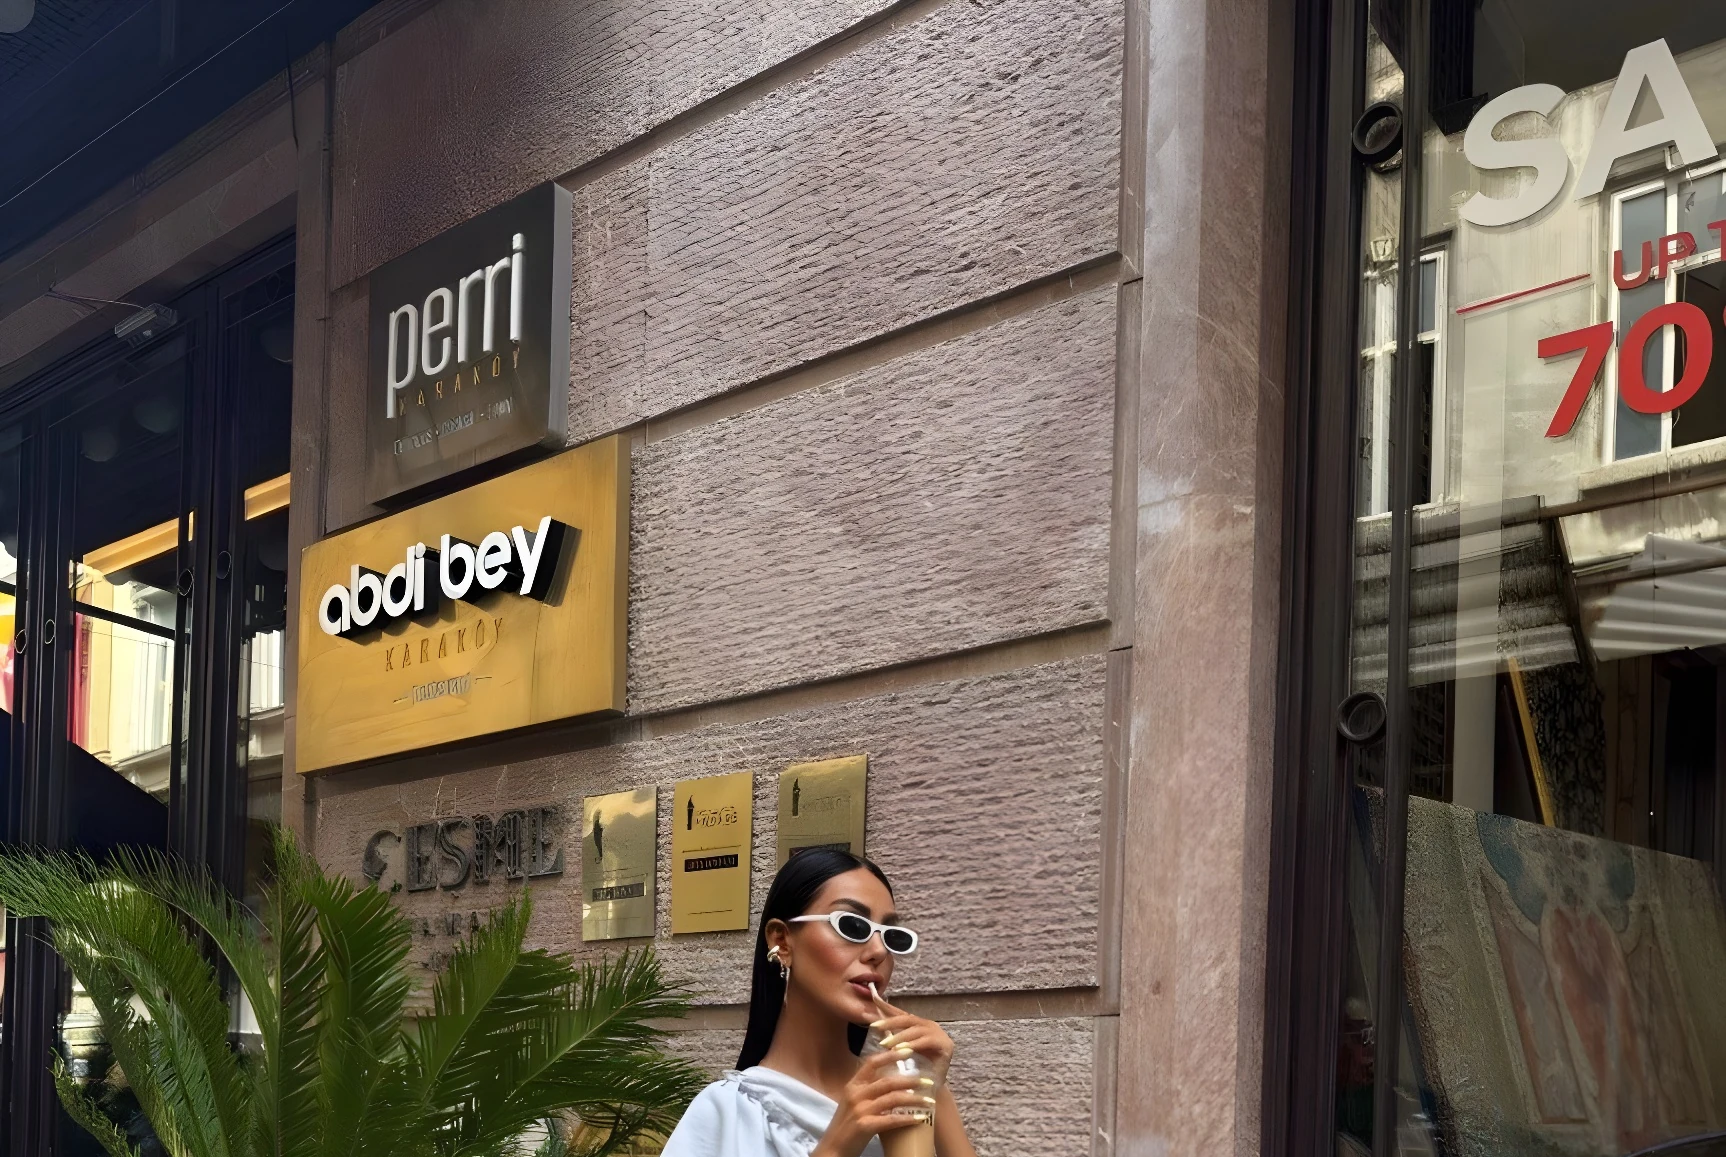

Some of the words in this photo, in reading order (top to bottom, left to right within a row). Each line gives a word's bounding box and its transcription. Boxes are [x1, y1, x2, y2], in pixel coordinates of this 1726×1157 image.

[1459, 38, 1718, 227] SA
[386, 232, 524, 419] perri
[1614, 231, 1696, 290] UP
[1538, 301, 1726, 439] 70
[318, 541, 425, 637] abdi
[439, 516, 553, 600] bey
